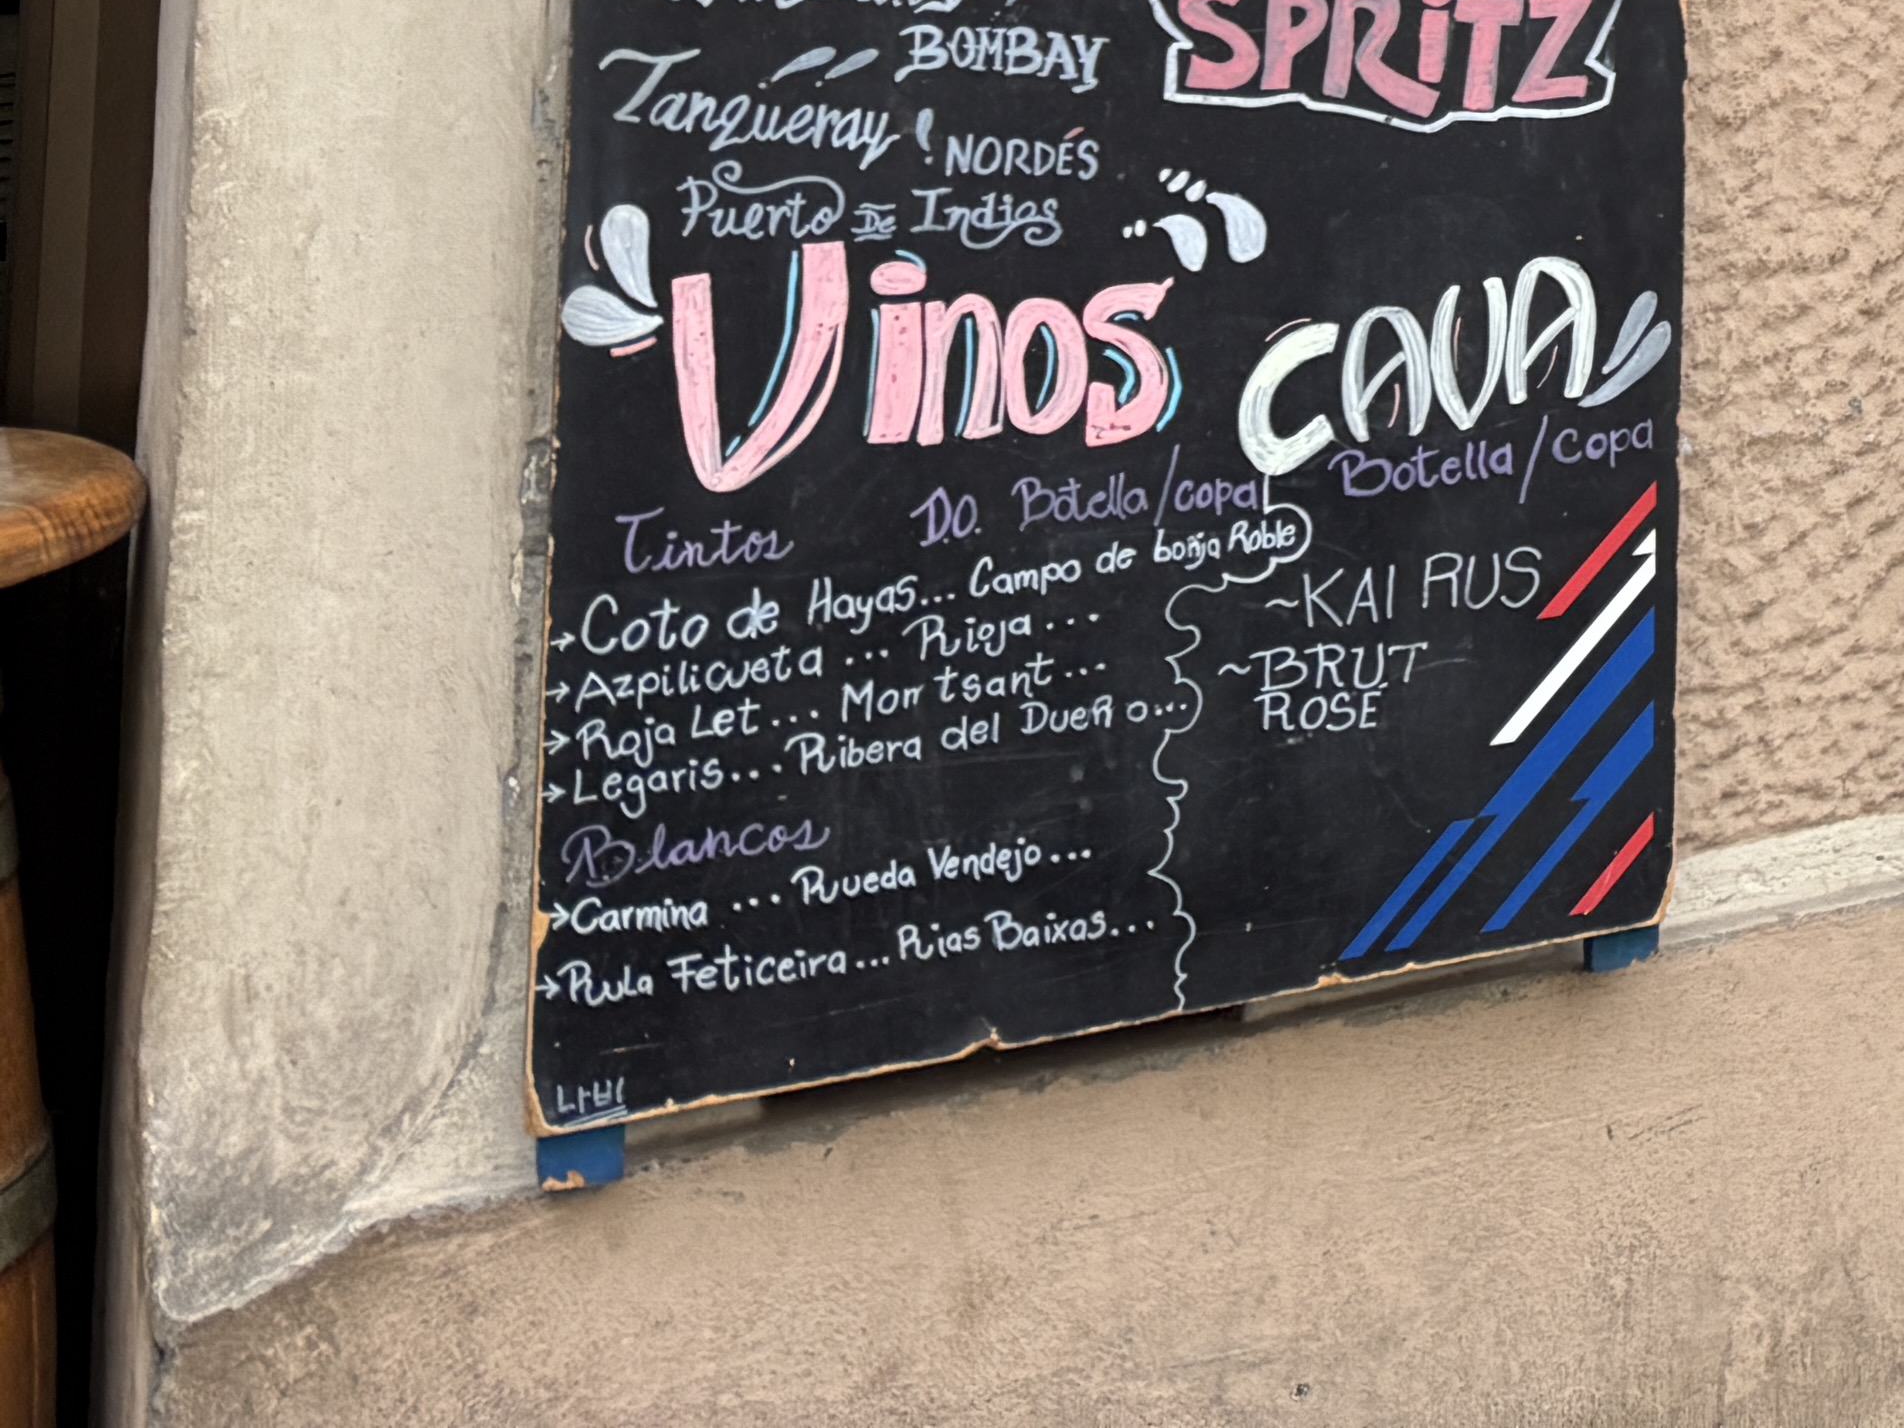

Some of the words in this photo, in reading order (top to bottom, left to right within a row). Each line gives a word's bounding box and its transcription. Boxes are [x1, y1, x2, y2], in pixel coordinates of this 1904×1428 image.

[895, 25, 1109, 94] BOMBAY
[599, 48, 900, 170] Tanqueray
[677, 160, 846, 238] Puerto
[616, 508, 794, 574] Tintos
[581, 593, 709, 656] Coto
[726, 587, 780, 640] de
[969, 555, 1082, 599] Campo
[1096, 541, 1137, 576] de
[1227, 519, 1296, 555] Roble
[575, 644, 823, 714] Azpilicueta
[1250, 642, 1429, 692] BRUT
[785, 731, 922, 776] Ribera
[941, 711, 1000, 752] del
[562, 818, 831, 888] Blancos
[570, 897, 708, 935] Carmina
